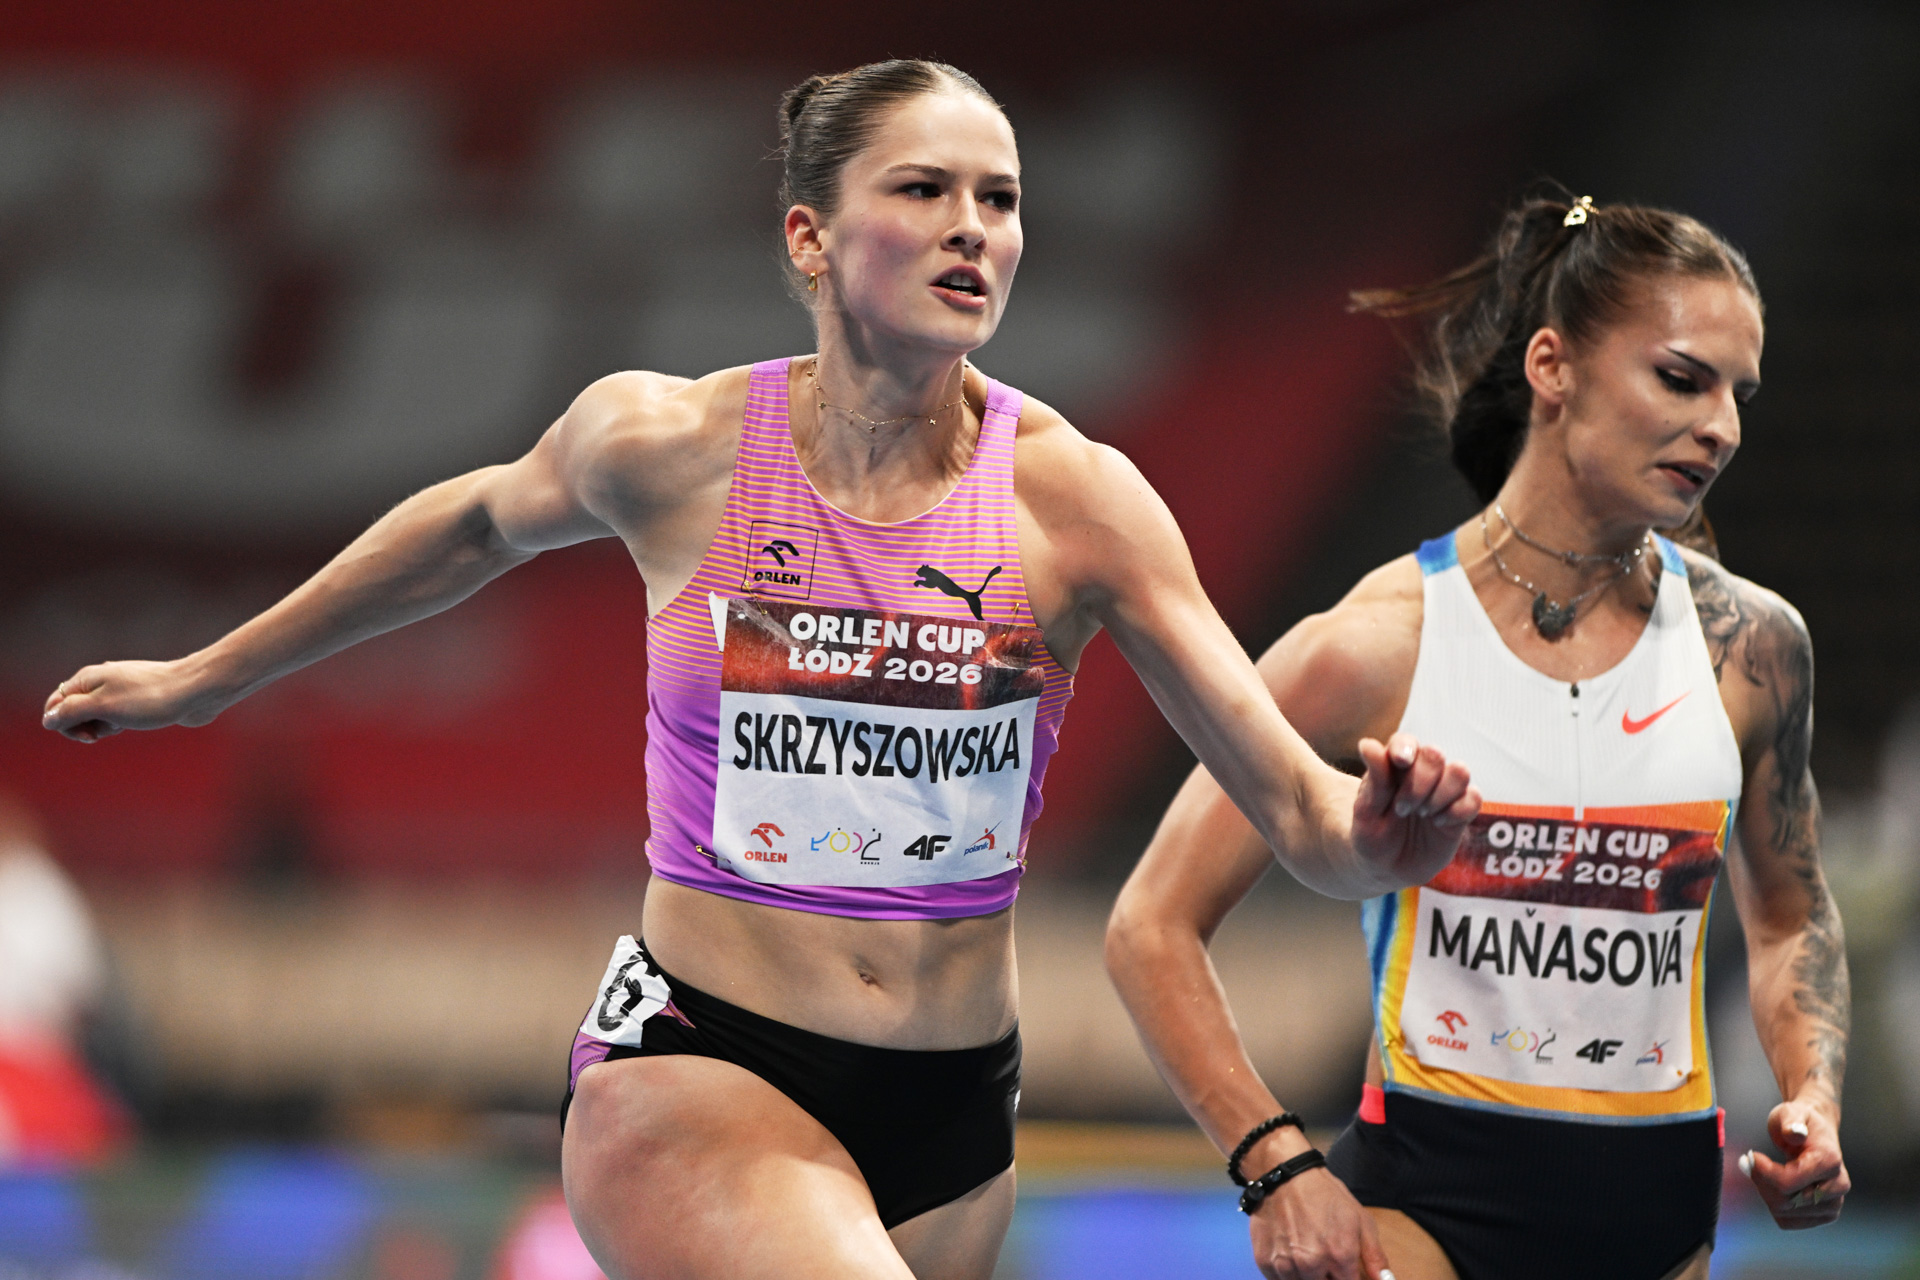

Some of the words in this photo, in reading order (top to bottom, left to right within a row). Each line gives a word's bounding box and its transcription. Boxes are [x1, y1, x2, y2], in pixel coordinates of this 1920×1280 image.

[753, 571, 801, 586] ORLEN
[789, 612, 909, 649] ORLEN
[916, 623, 986, 655] CUP
[788, 644, 874, 678] ŁÓDŹ
[884, 658, 982, 685] 2026
[733, 711, 1020, 784] SKRZYSZOWSKA
[744, 850, 788, 863] ORLEN
[903, 834, 952, 860] 4F
[1487, 821, 1600, 854] ORLEN
[1605, 831, 1669, 860] CUP
[1484, 850, 1563, 881] ŁÓDŹ
[1574, 863, 1662, 890] 2026
[1429, 907, 1686, 987] MAŇASOVÁ
[1427, 1034, 1469, 1052] ORLEN
[1576, 1039, 1624, 1064] 4F
